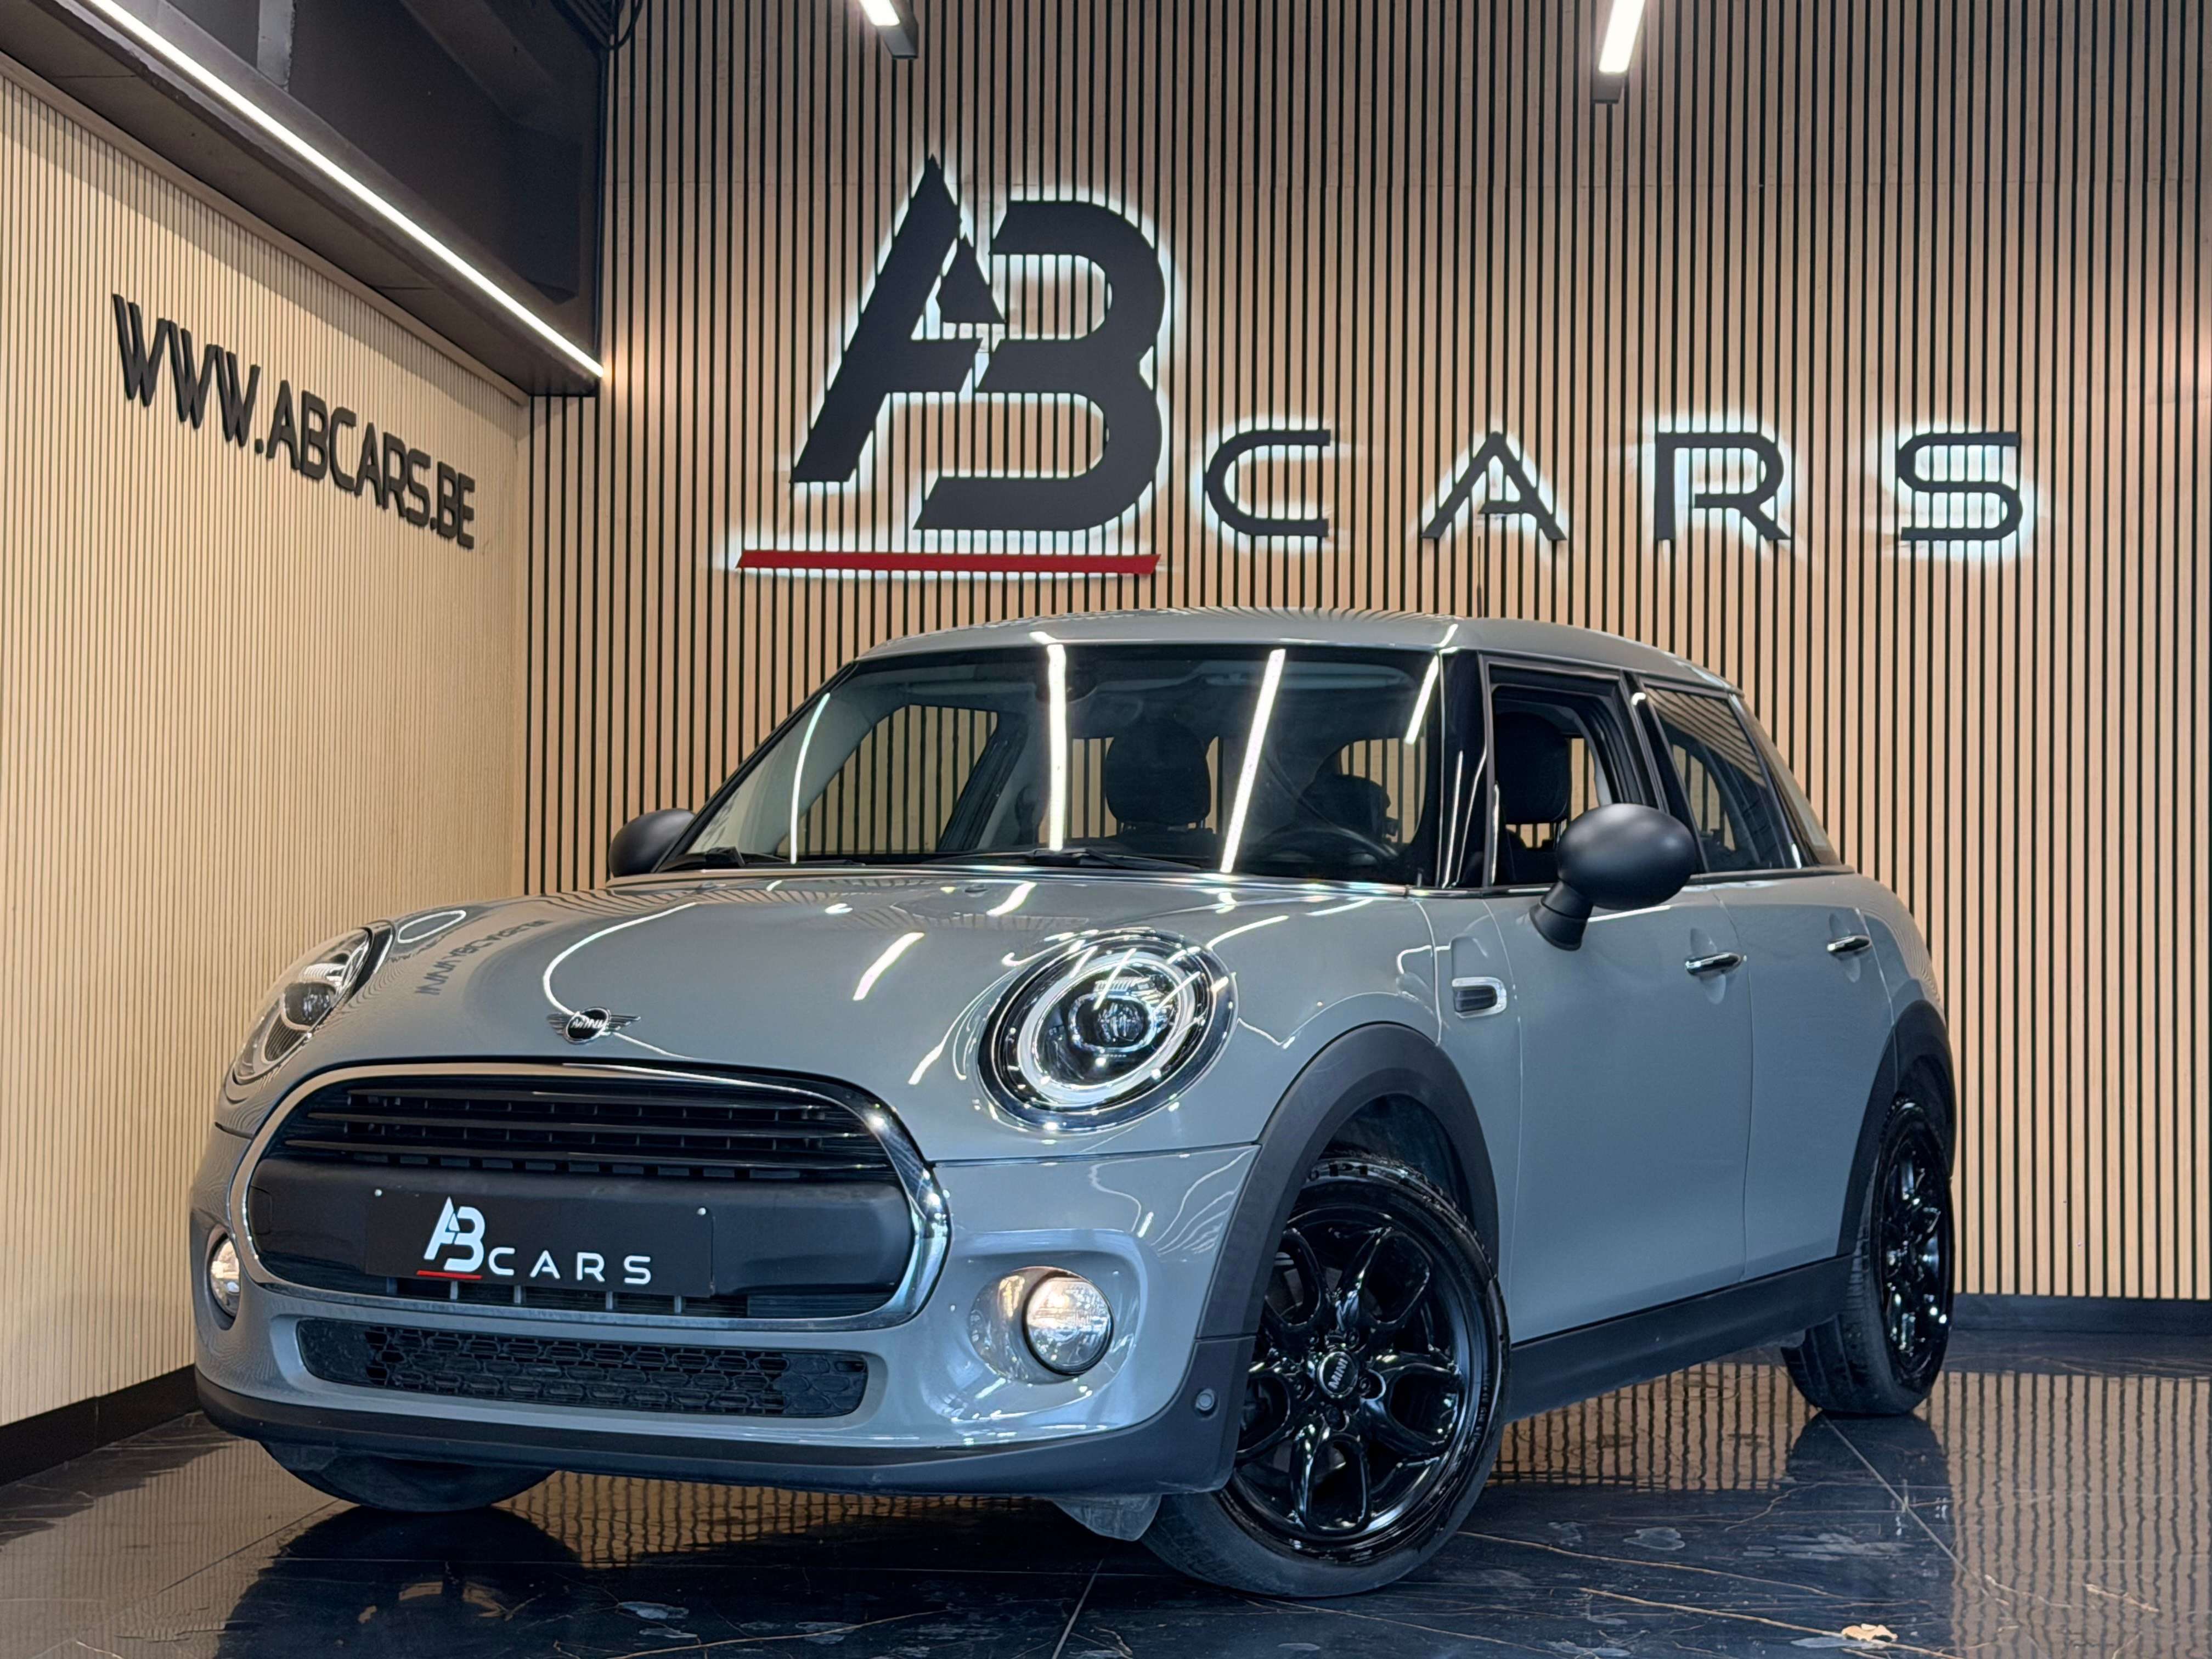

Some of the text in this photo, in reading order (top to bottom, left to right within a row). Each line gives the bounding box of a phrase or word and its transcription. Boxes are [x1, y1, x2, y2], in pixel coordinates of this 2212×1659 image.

[112, 293, 475, 550] WWW.ABCARS.BE
[1205, 429, 2023, 541] CARS
[488, 1247, 651, 1285] CARS
[1328, 1357, 1348, 1390] MINI
